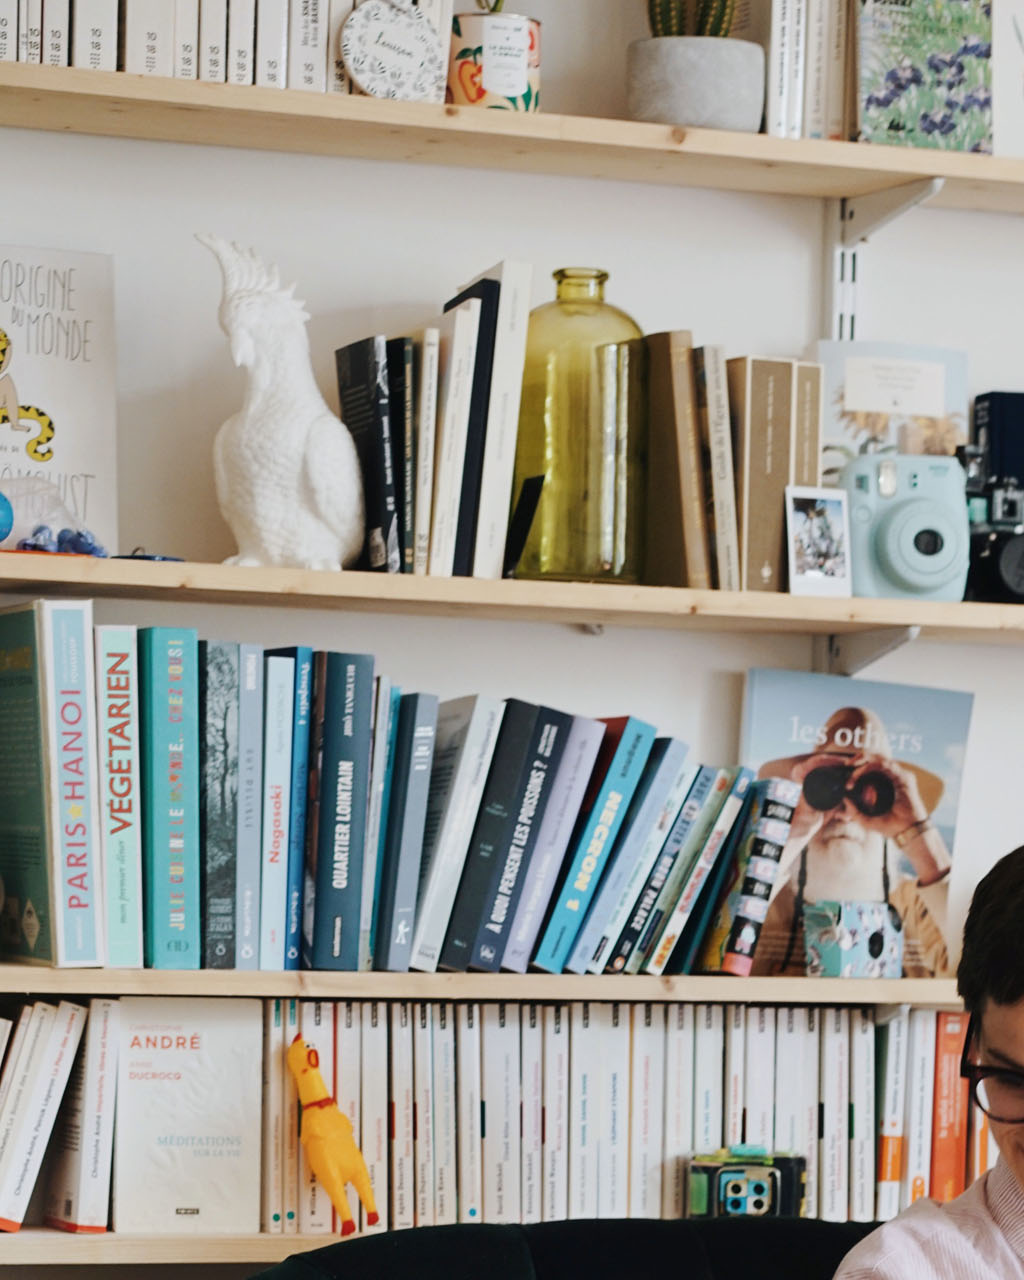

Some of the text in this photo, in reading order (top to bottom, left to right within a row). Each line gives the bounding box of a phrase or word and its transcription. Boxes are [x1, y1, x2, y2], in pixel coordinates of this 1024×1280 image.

[26, 312, 94, 363] MONDE
[168, 688, 185, 724] CHEZ
[106, 652, 134, 835] VÉGÉTARIEN
[787, 714, 923, 754] les others
[60, 689, 90, 909] PARIS HANOI
[168, 808, 185, 826] LE
[519, 769, 545, 825] POISSONS
[268, 785, 285, 864] Nagasaki
[332, 760, 354, 889] QUARTIER LOINTAIN
[511, 823, 530, 846] LES
[499, 843, 524, 895] PENSENT
[565, 789, 625, 912] NECRON 1
[169, 891, 186, 931] JULIE
[632, 888, 660, 932] PALACE
[130, 1032, 201, 1050] ANDRÉ
[128, 1071, 182, 1081] DUCROCQ
[157, 1134, 242, 1146] MÉDITATIONS
